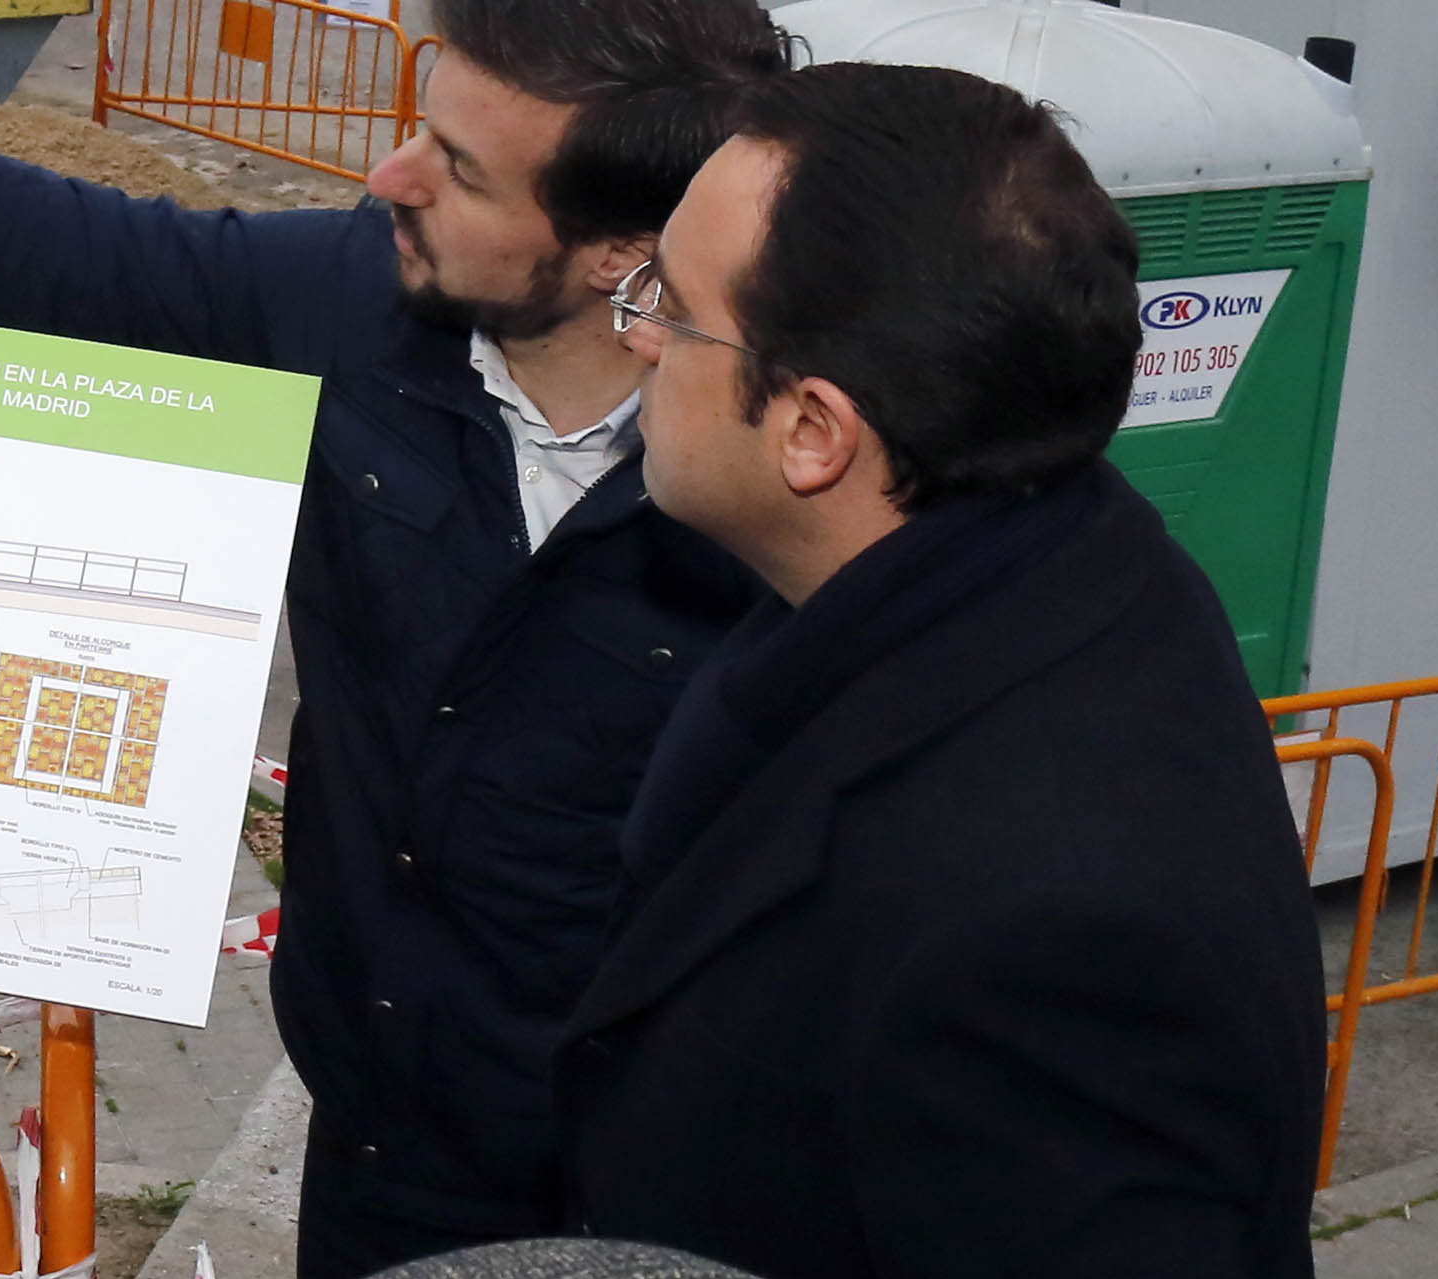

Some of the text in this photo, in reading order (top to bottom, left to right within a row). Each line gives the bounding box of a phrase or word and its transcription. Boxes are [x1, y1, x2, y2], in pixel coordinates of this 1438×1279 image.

[1160, 295, 1263, 323] PK KLYN
[1134, 344, 1239, 377] 902 105 305
[2, 362, 34, 386] EN
[38, 366, 70, 391] LA
[73, 372, 146, 403] PLAZA
[150, 384, 183, 408] DE
[186, 388, 216, 413] LA
[1129, 385, 1213, 407] GUER ALQUILER
[1, 388, 92, 419] MADRID
[49, 629, 80, 642] DETALLE
[81, 635, 91, 643] DE
